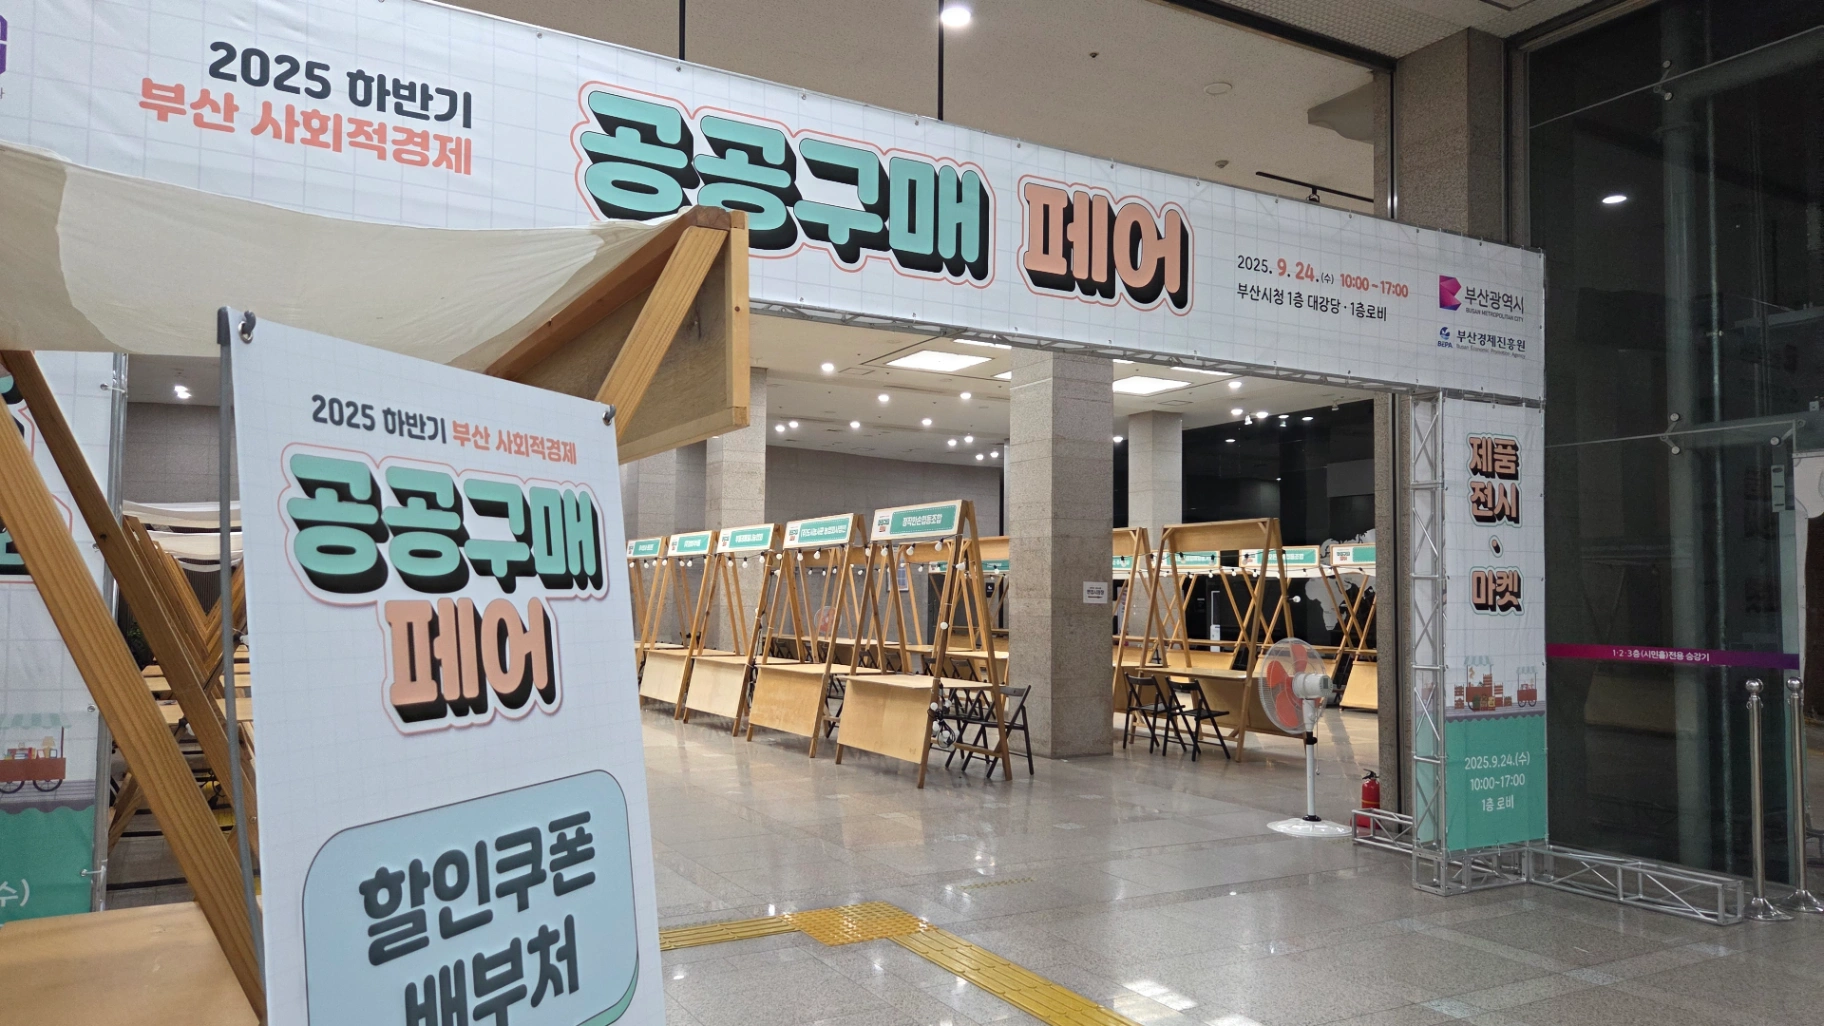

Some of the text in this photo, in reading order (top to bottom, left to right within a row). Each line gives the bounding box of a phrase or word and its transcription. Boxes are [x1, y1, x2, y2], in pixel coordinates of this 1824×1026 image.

[209, 41, 472, 129] 2025 하반기
[139, 78, 472, 176] 부산 사회적경제
[579, 90, 1189, 310] 공공구매 페어
[1237, 255, 1273, 275] 2025.
[1237, 282, 1284, 305] 부산시청
[1287, 291, 1304, 308] 1층
[1464, 286, 1524, 315] 부산광역시
[1465, 307, 1481, 315] BUSAN
[1456, 329, 1526, 353] 부산경제진흥원
[311, 394, 578, 466] 2025 하반기 부산 사회적경제
[1469, 436, 1520, 481] 제품
[286, 453, 604, 595] 공공구매
[1469, 480, 1520, 525] 전시
[1471, 569, 1523, 612] 마켓
[384, 596, 556, 724] 페어
[1685, 652, 1710, 662] 승강기
[1464, 751, 1530, 770] 2025.9.24.(수)
[1470, 773, 1525, 791] 10:00~17:00
[1481, 794, 1514, 812] 1층 로비
[358, 810, 596, 967] 할인쿠폰
[404, 913, 580, 1026] 배부처
